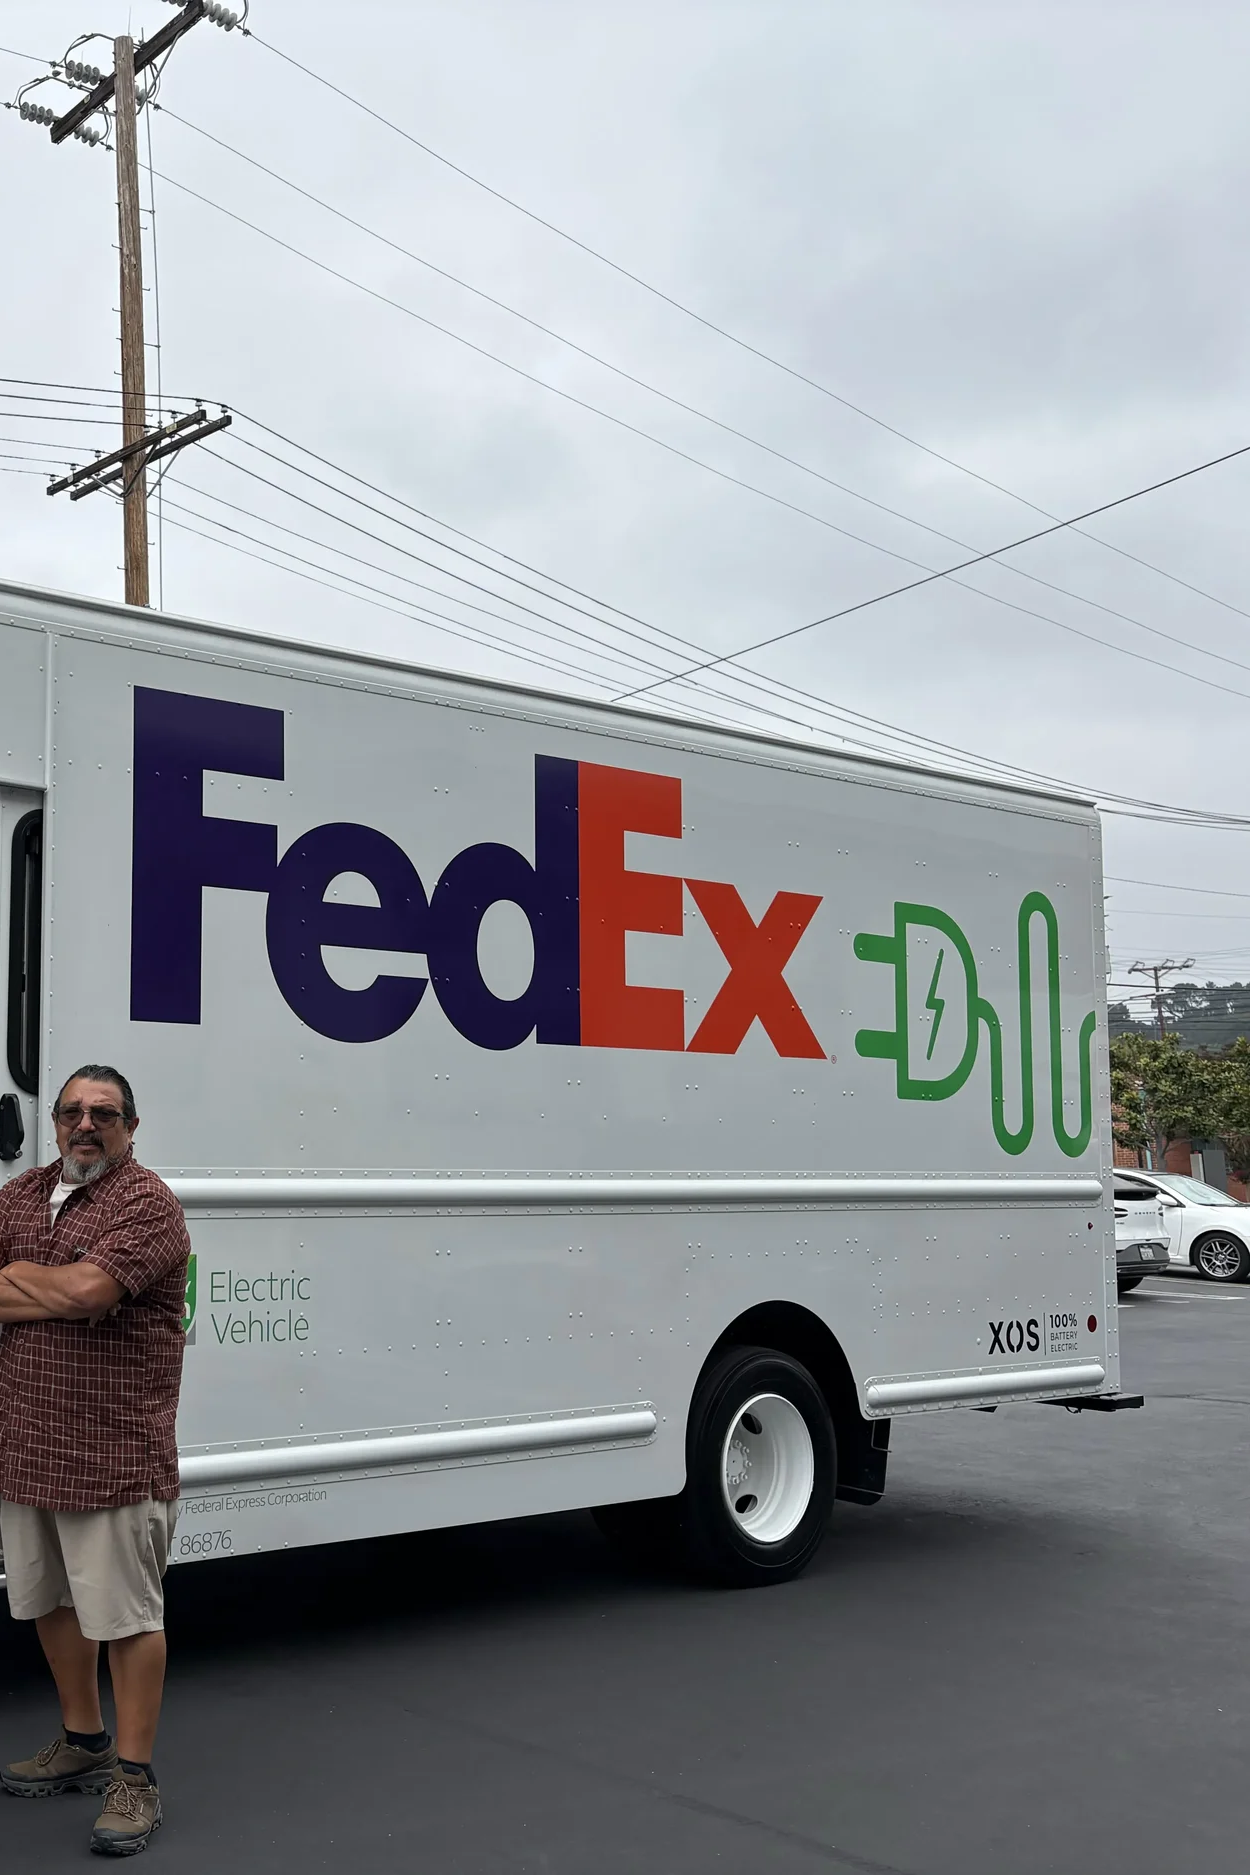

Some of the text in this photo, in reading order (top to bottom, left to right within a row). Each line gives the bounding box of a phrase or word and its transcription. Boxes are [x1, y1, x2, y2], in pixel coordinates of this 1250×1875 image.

[130, 685, 828, 1060] FedEx
[210, 1270, 311, 1303] Electric
[211, 1309, 309, 1344] Vehicle
[1049, 1313, 1078, 1328] 100%
[988, 1318, 1040, 1355] XOS
[1050, 1330, 1078, 1341] BATTERY
[1050, 1342, 1078, 1352] ELECTRIC
[185, 1498, 224, 1514] Federal
[226, 1494, 266, 1512] Express
[267, 1489, 327, 1506] Corporation
[180, 1529, 232, 1555] 86876
